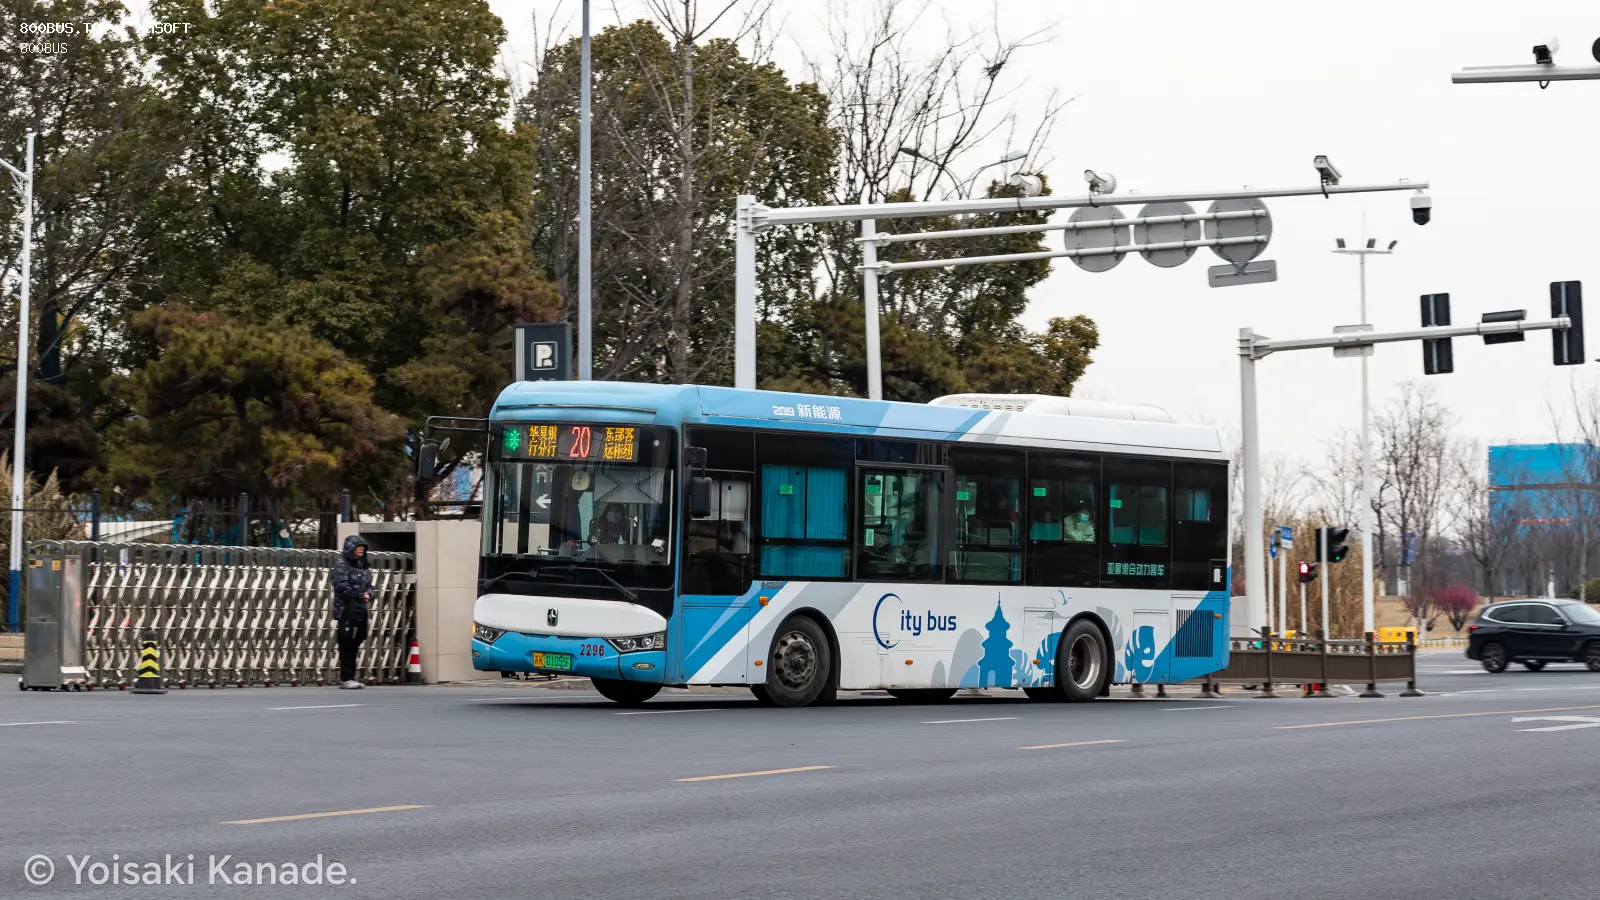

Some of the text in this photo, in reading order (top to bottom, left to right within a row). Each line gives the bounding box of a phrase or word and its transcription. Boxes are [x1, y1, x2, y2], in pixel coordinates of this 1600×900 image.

[796, 403, 842, 420] 新能源
[569, 426, 591, 458] 20
[872, 593, 957, 649] City bus
[580, 643, 605, 657] 2296
